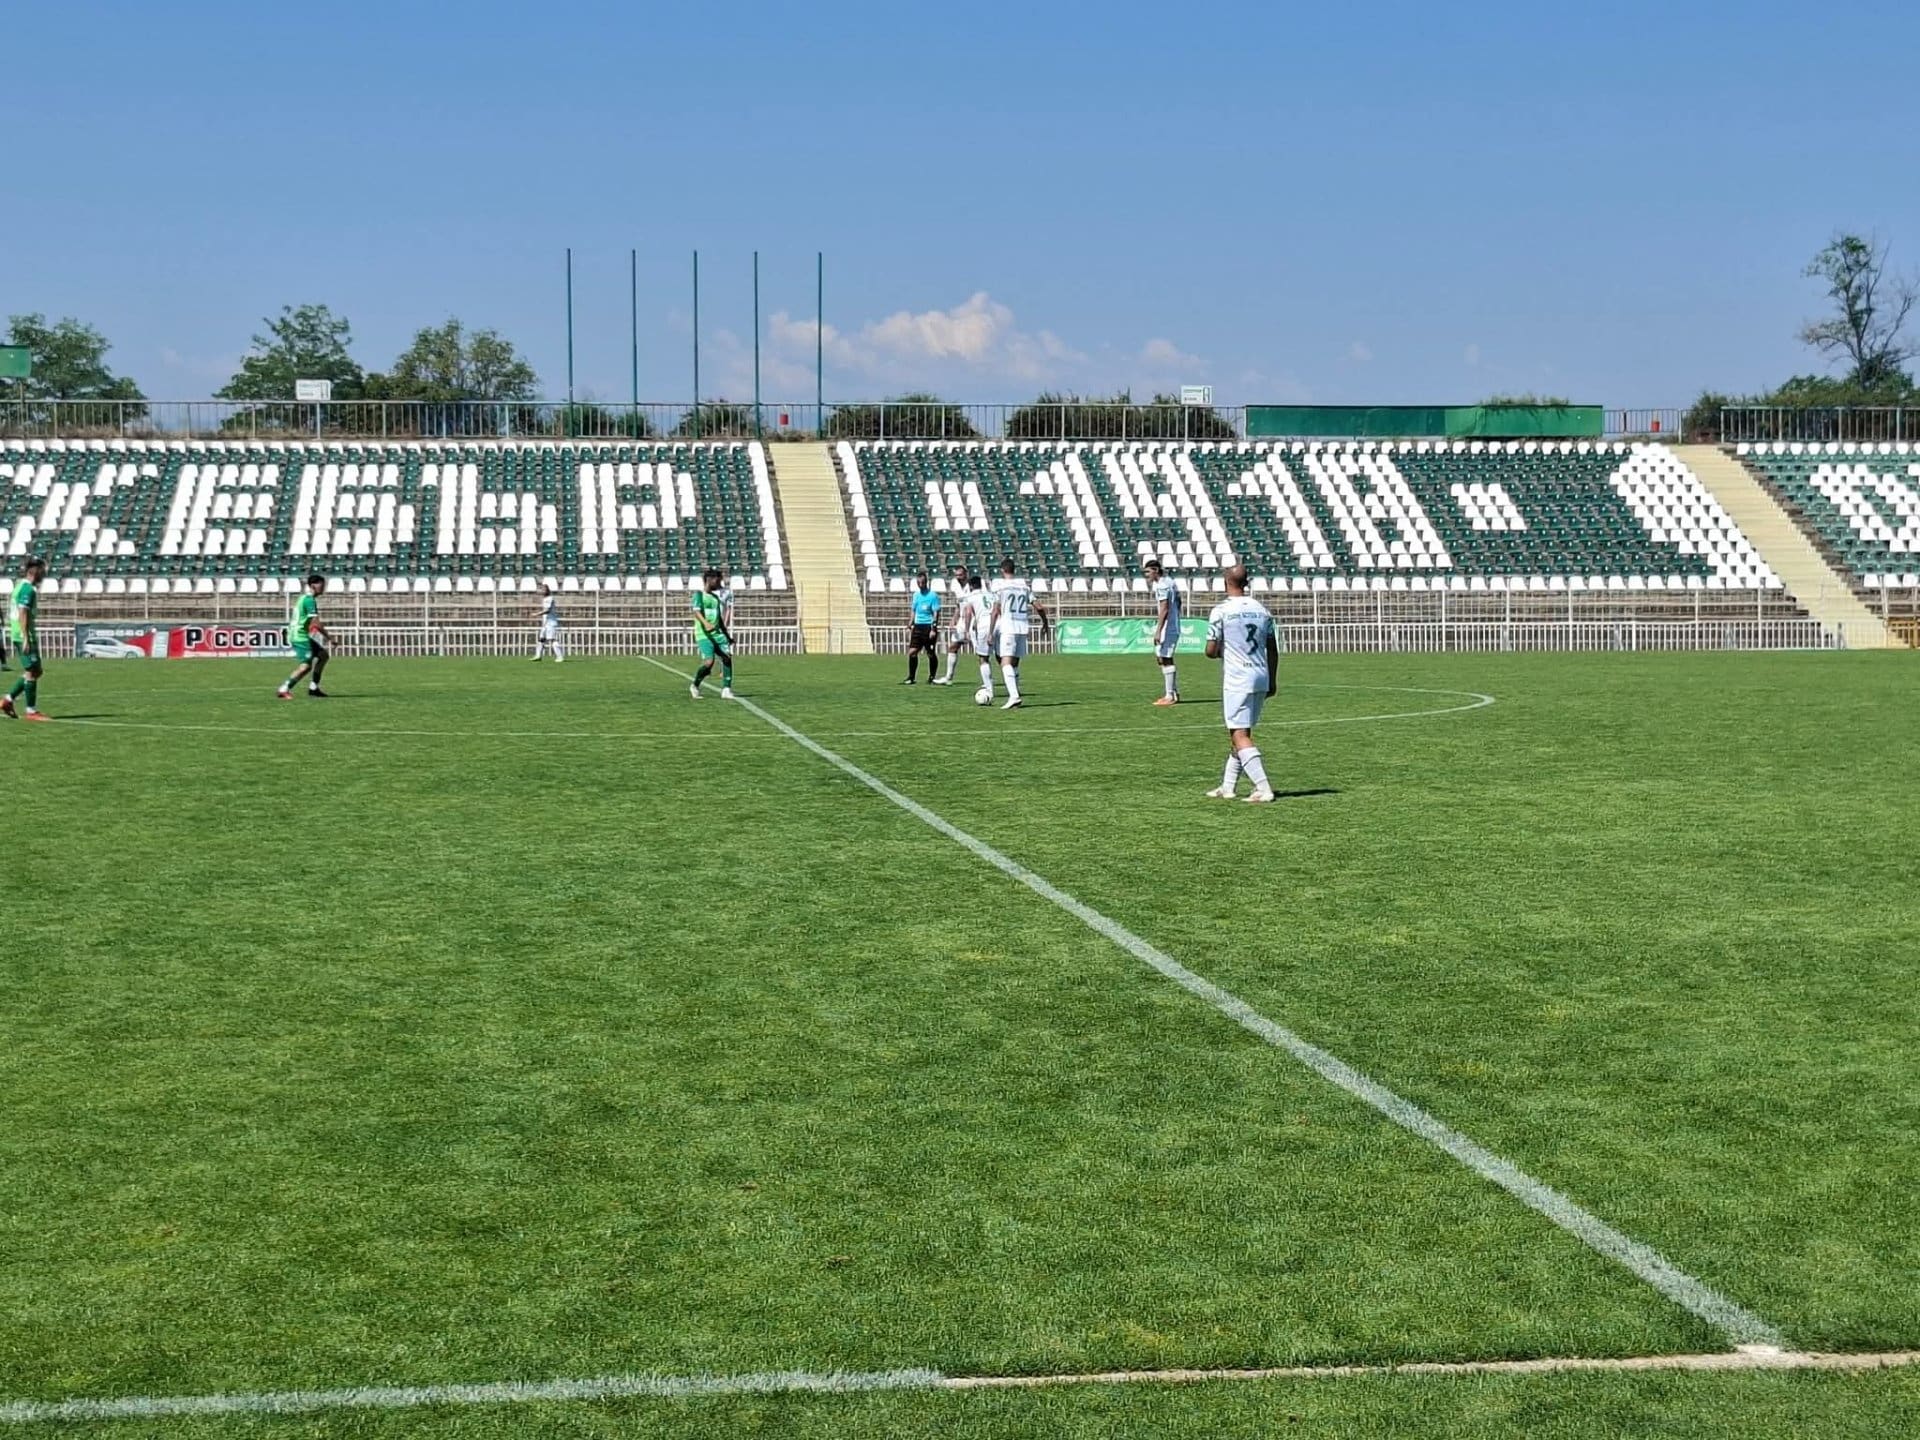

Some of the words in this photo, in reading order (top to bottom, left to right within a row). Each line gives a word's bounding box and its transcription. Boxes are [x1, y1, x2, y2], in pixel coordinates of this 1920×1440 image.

[1007, 593, 1027, 614] 22
[185, 626, 293, 649] Piccant
[1245, 623, 1259, 656] 3
